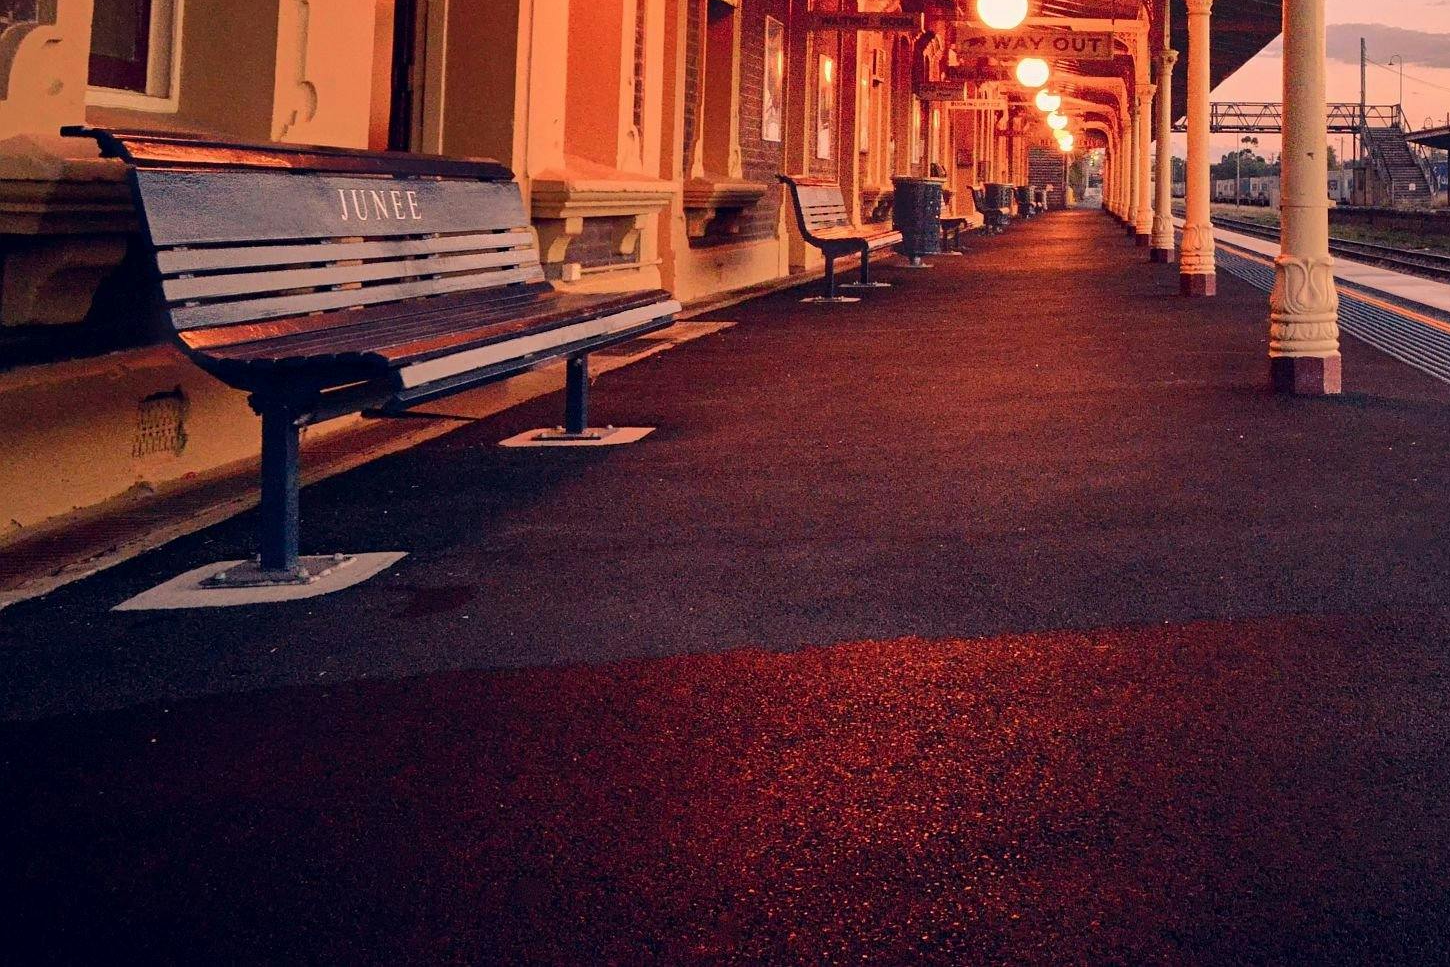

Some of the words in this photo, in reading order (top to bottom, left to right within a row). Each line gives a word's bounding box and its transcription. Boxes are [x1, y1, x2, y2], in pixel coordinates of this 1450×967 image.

[991, 35, 1044, 50] WAY
[1052, 37, 1102, 53] OUT
[337, 188, 423, 221] JUNEE
